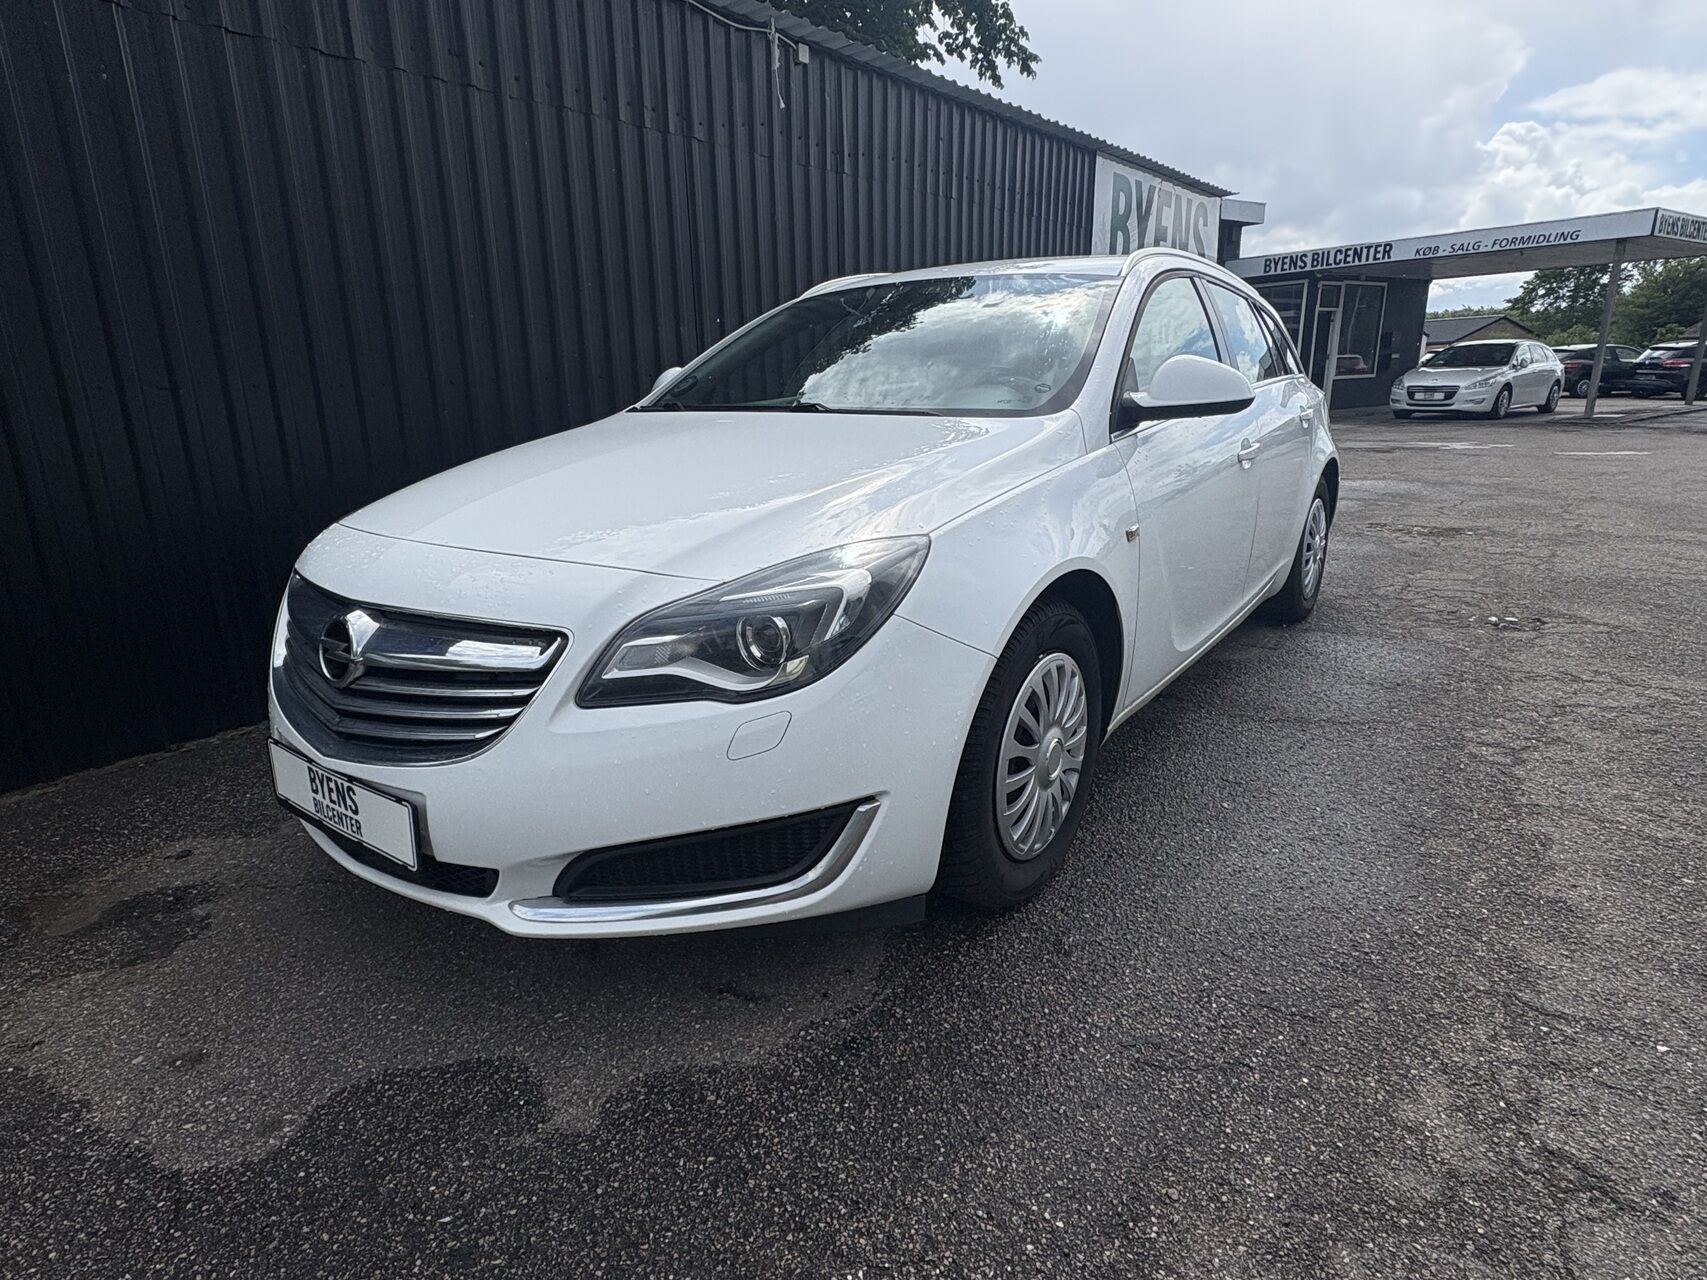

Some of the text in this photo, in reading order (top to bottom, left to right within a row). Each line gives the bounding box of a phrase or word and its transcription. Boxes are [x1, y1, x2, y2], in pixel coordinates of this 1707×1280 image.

[1109, 171, 1208, 258] BYENS
[1658, 213, 1680, 237] BYENS
[1263, 243, 1394, 274] BYENS BILCENTER
[1414, 246, 1440, 257] KØB
[1450, 240, 1482, 254] SALG
[1491, 229, 1582, 249] FORMIDLING
[307, 765, 360, 816] BYENS
[312, 796, 364, 838] BILCENTER
